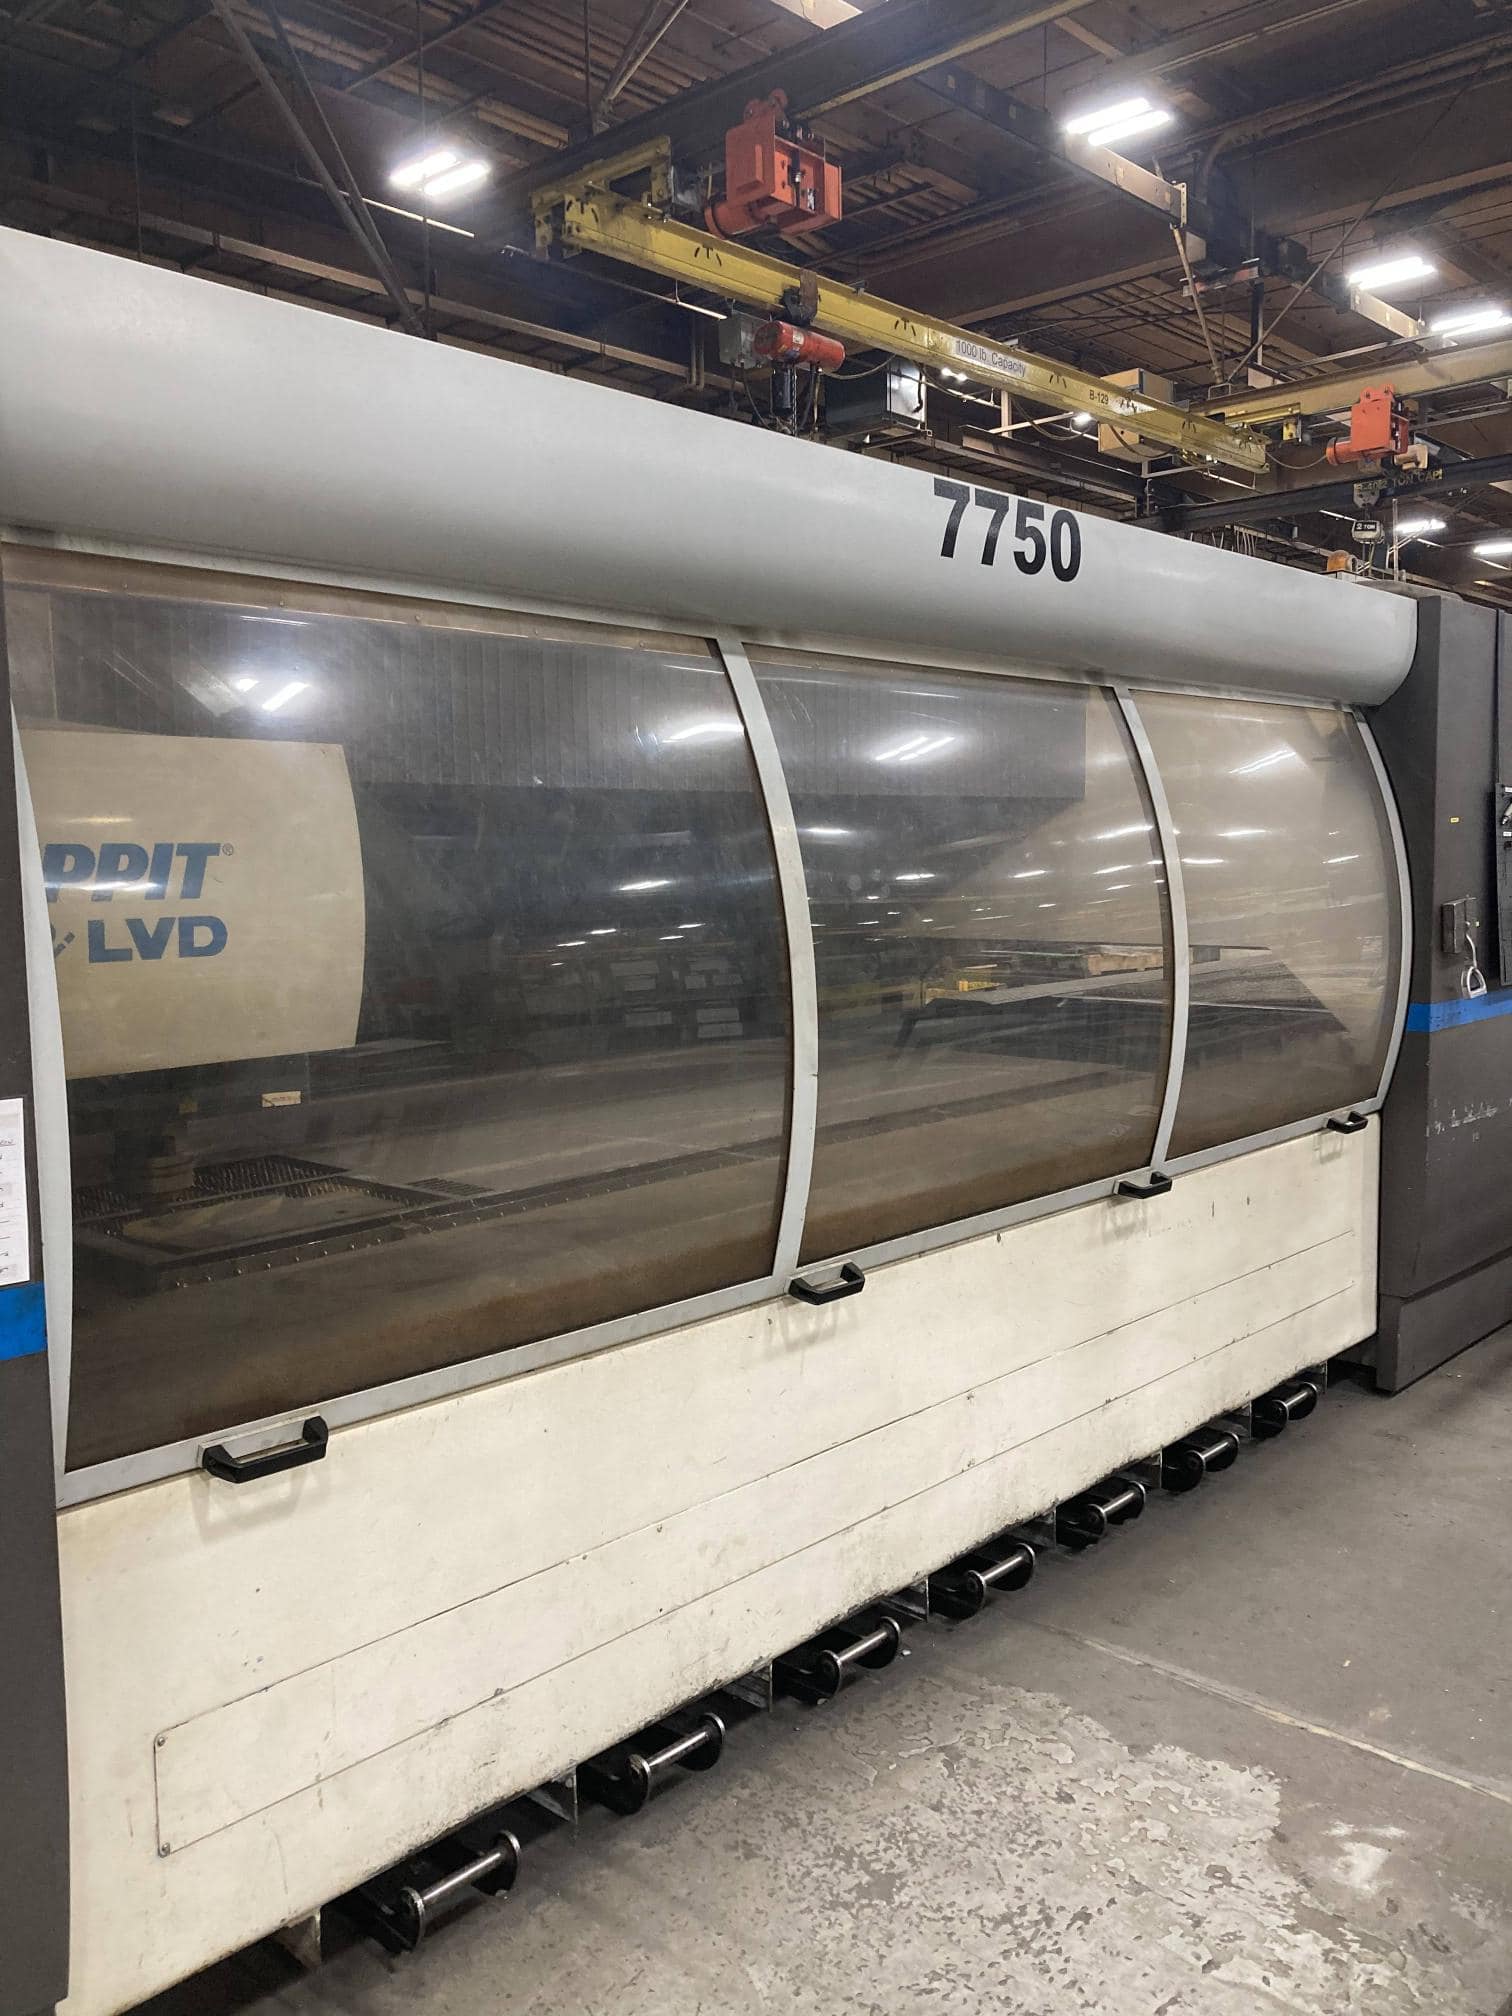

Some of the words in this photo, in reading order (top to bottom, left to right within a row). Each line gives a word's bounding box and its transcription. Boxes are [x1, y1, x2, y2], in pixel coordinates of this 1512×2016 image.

[956, 341, 977, 358] 1000
[991, 352, 1026, 378] Capacity
[1089, 389, 1109, 405] B-129
[933, 477, 1082, 583] 7750
[87, 915, 229, 964] LVD
